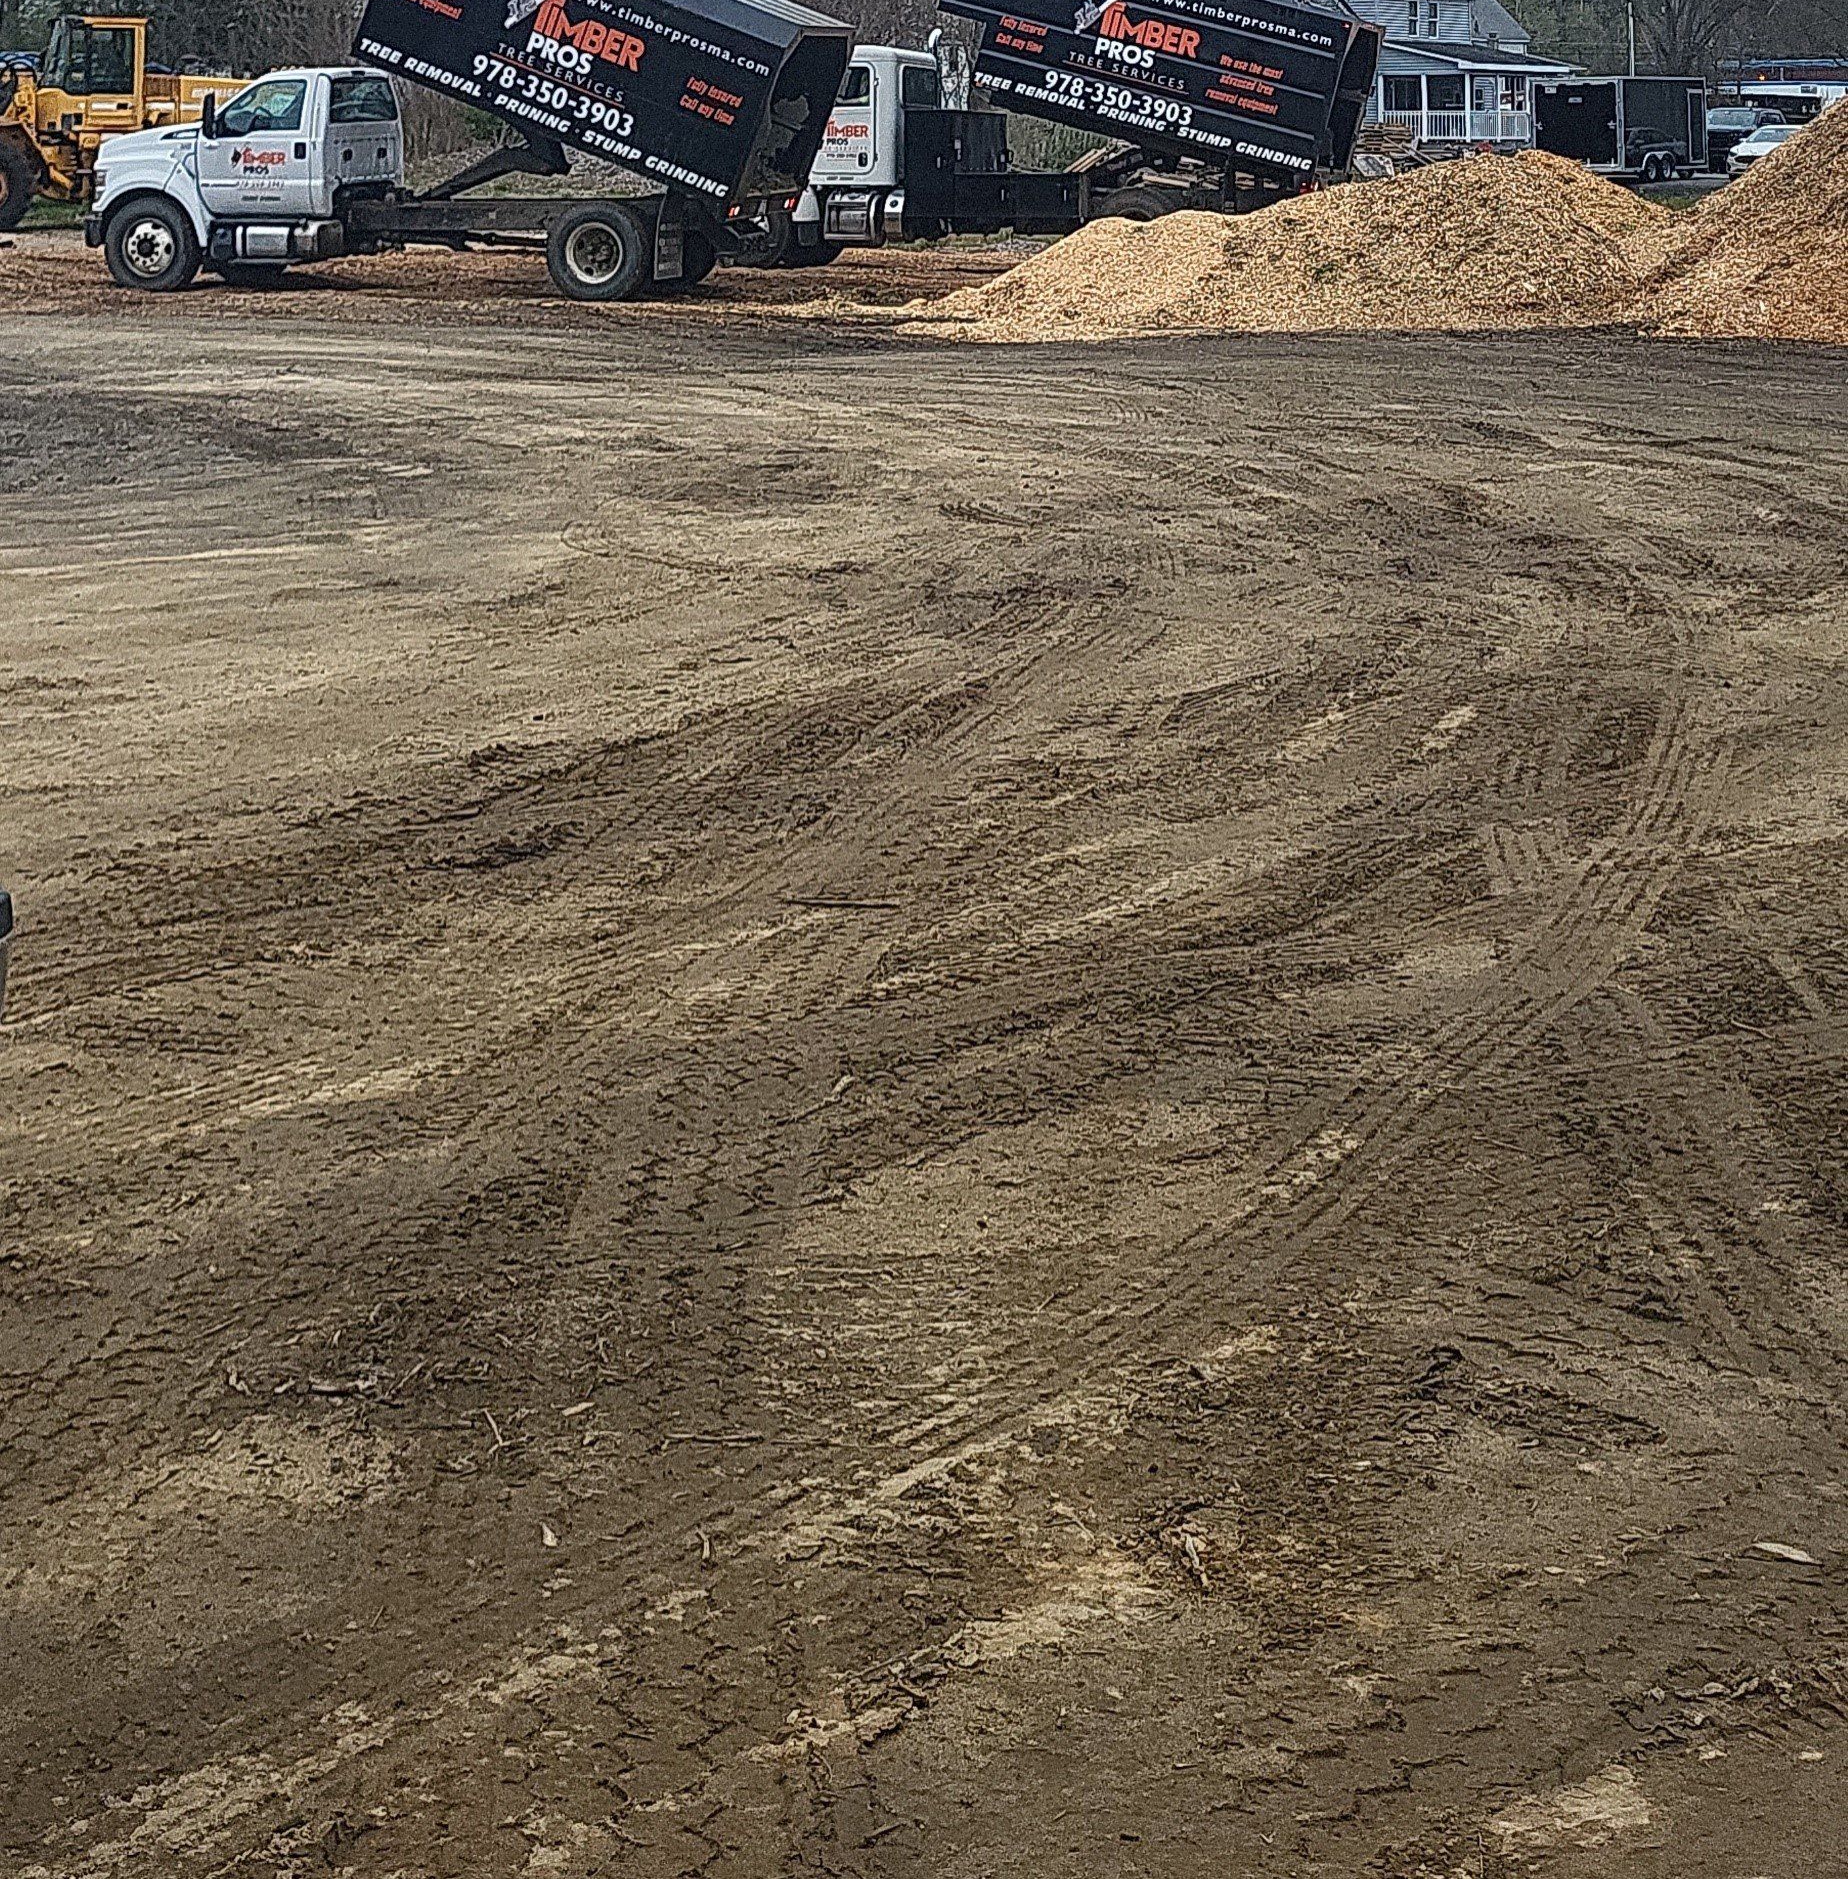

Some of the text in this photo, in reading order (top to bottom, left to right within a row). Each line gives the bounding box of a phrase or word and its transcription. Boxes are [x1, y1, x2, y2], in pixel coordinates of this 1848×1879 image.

[526, 31, 594, 74] PROS
[1095, 37, 1156, 68] PROS
[1100, 1, 1200, 59] TIMBER
[473, 54, 634, 137] 978-350-3903
[498, 42, 625, 103] TREE SERVICES
[1045, 70, 1193, 126] 978-350-3903
[1069, 51, 1185, 90] TREE SERVICES
[359, 37, 729, 198] TREE REMOVAL PRUNING STUMP GRINDING
[826, 138, 849, 146] PROS
[974, 71, 1313, 171] TREE REMOVAL PRUNING STUMP GRINDING
